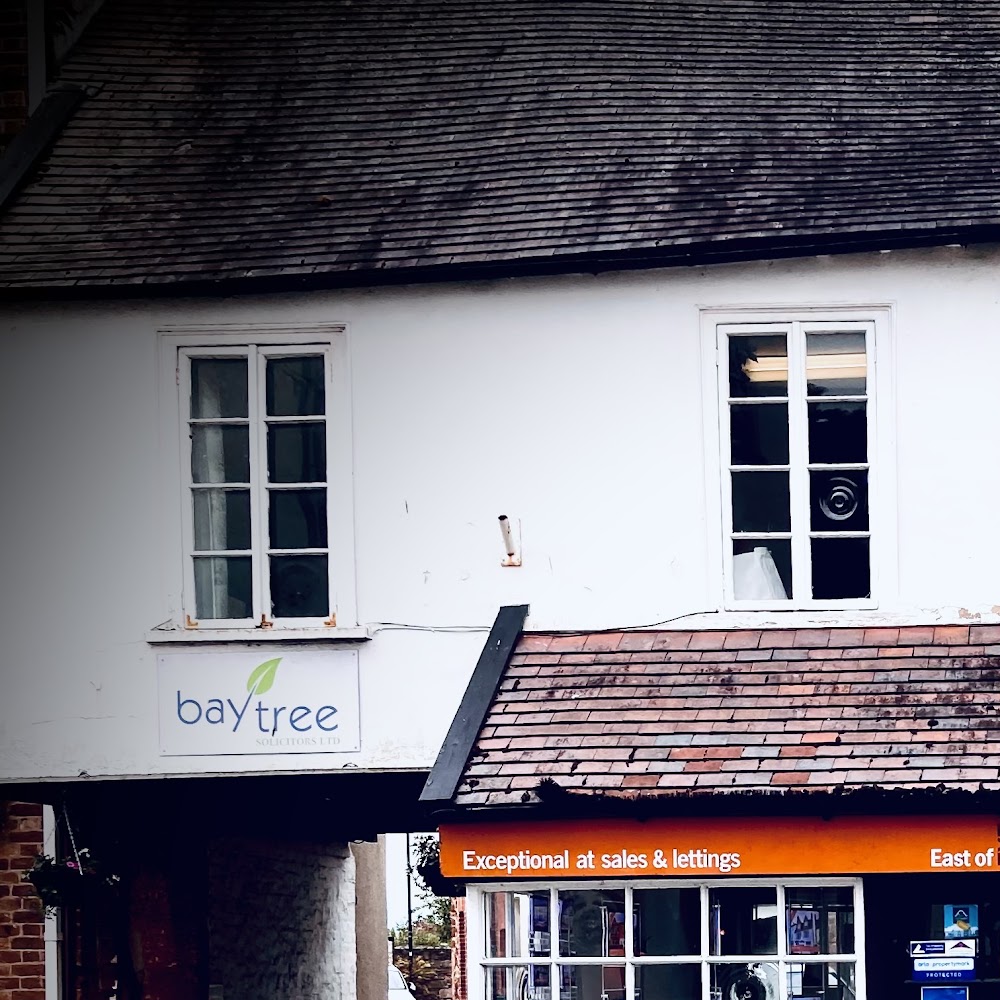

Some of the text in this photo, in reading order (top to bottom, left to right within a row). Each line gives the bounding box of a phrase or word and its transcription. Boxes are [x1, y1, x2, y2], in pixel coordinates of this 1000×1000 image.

[256, 736, 341, 746] SOLICITORS LTD
[463, 849, 741, 874] Exceptional at sales & lettings
[930, 848, 971, 867] East
[974, 848, 994, 867] of
